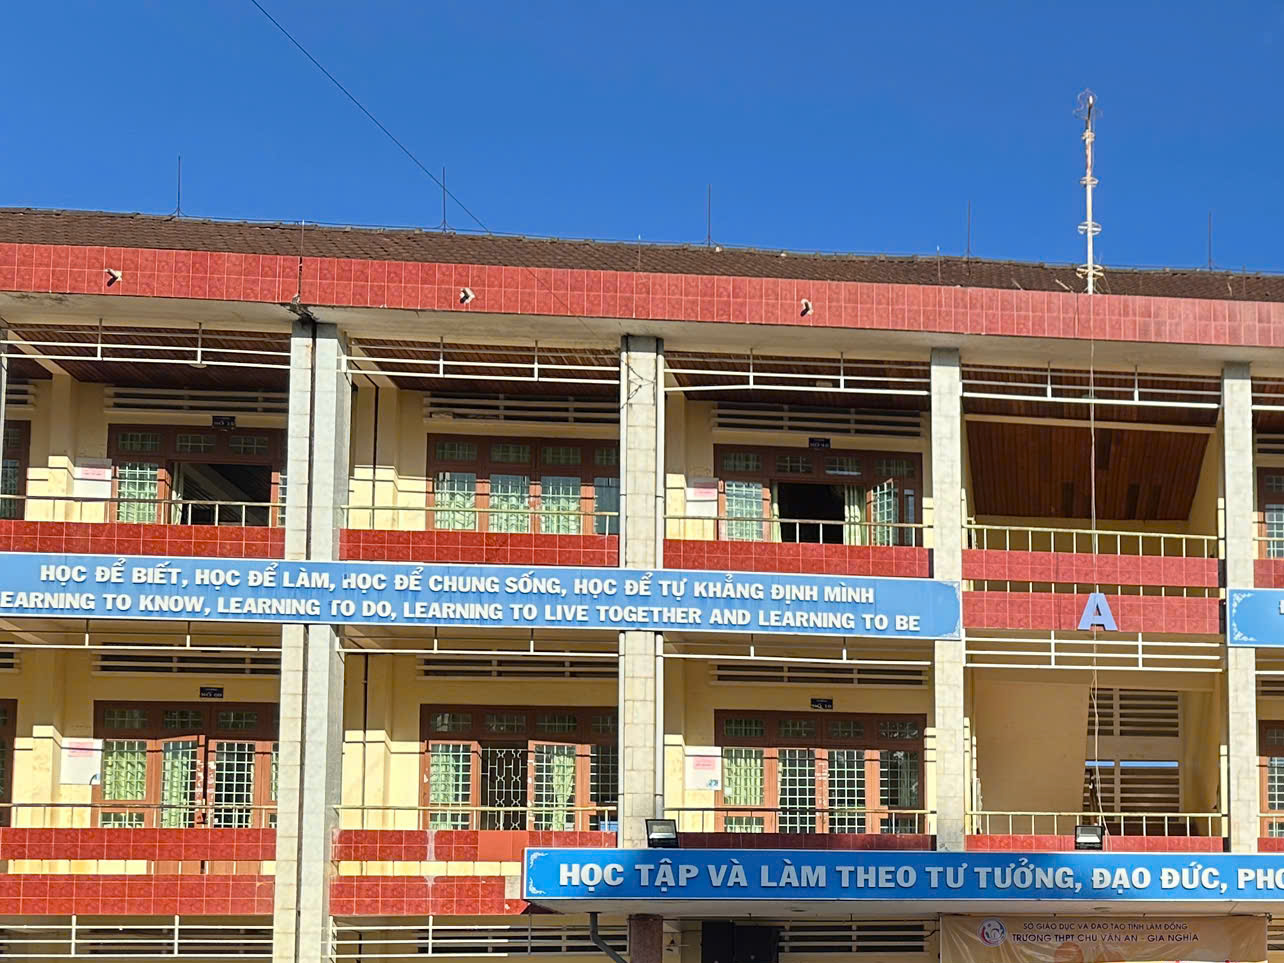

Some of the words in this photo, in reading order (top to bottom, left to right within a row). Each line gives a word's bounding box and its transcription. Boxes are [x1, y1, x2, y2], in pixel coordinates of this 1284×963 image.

[40, 565, 87, 586] HỌC
[95, 558, 126, 583] ĐỂ
[132, 561, 189, 588] BIẾT,
[195, 568, 240, 590] HỌC
[248, 562, 279, 587] ĐỂ
[283, 568, 336, 591] LÀM,
[342, 572, 387, 593] HỌC
[394, 567, 424, 591] ĐỂ
[428, 575, 500, 593] CHUNG
[505, 571, 567, 597] SỐNG,
[574, 578, 617, 599] HỌC
[624, 572, 653, 596] ĐỂ
[658, 577, 688, 601] TỰ
[770, 584, 818, 605] ĐỊNH
[824, 582, 875, 604] MÌNH
[0, 591, 96, 611] EARNING
[102, 593, 132, 611] TO
[139, 594, 211, 616] KNOW,
[217, 596, 320, 616] LEARNING
[329, 600, 356, 617] TO
[362, 600, 397, 620] DO,
[403, 602, 503, 621] LEARNING
[510, 604, 537, 621] TO
[544, 604, 589, 622] LIVE
[596, 605, 702, 624] TOGETHER
[709, 608, 750, 625] AND
[758, 610, 855, 629] LEARNING
[862, 613, 889, 631] TO
[895, 615, 921, 632] BE
[1077, 592, 1119, 631] A
[559, 863, 625, 892] HỌC
[634, 858, 699, 892] TẬP
[707, 858, 749, 887] VÀ
[760, 858, 827, 888] LÀM
[835, 865, 917, 888] THEO
[925, 863, 968, 889] TƯ
[973, 857, 1083, 893] TƯỞNG,
[1091, 867, 1151, 894] ĐẠO
[1160, 861, 1228, 894] ĐỨC,
[1036, 922, 1057, 930] GIÁO
[1054, 934, 1074, 942] THPT
[1077, 934, 1097, 942] CHU
[1124, 934, 1138, 942] AN
[1147, 934, 1165, 942] GIA
